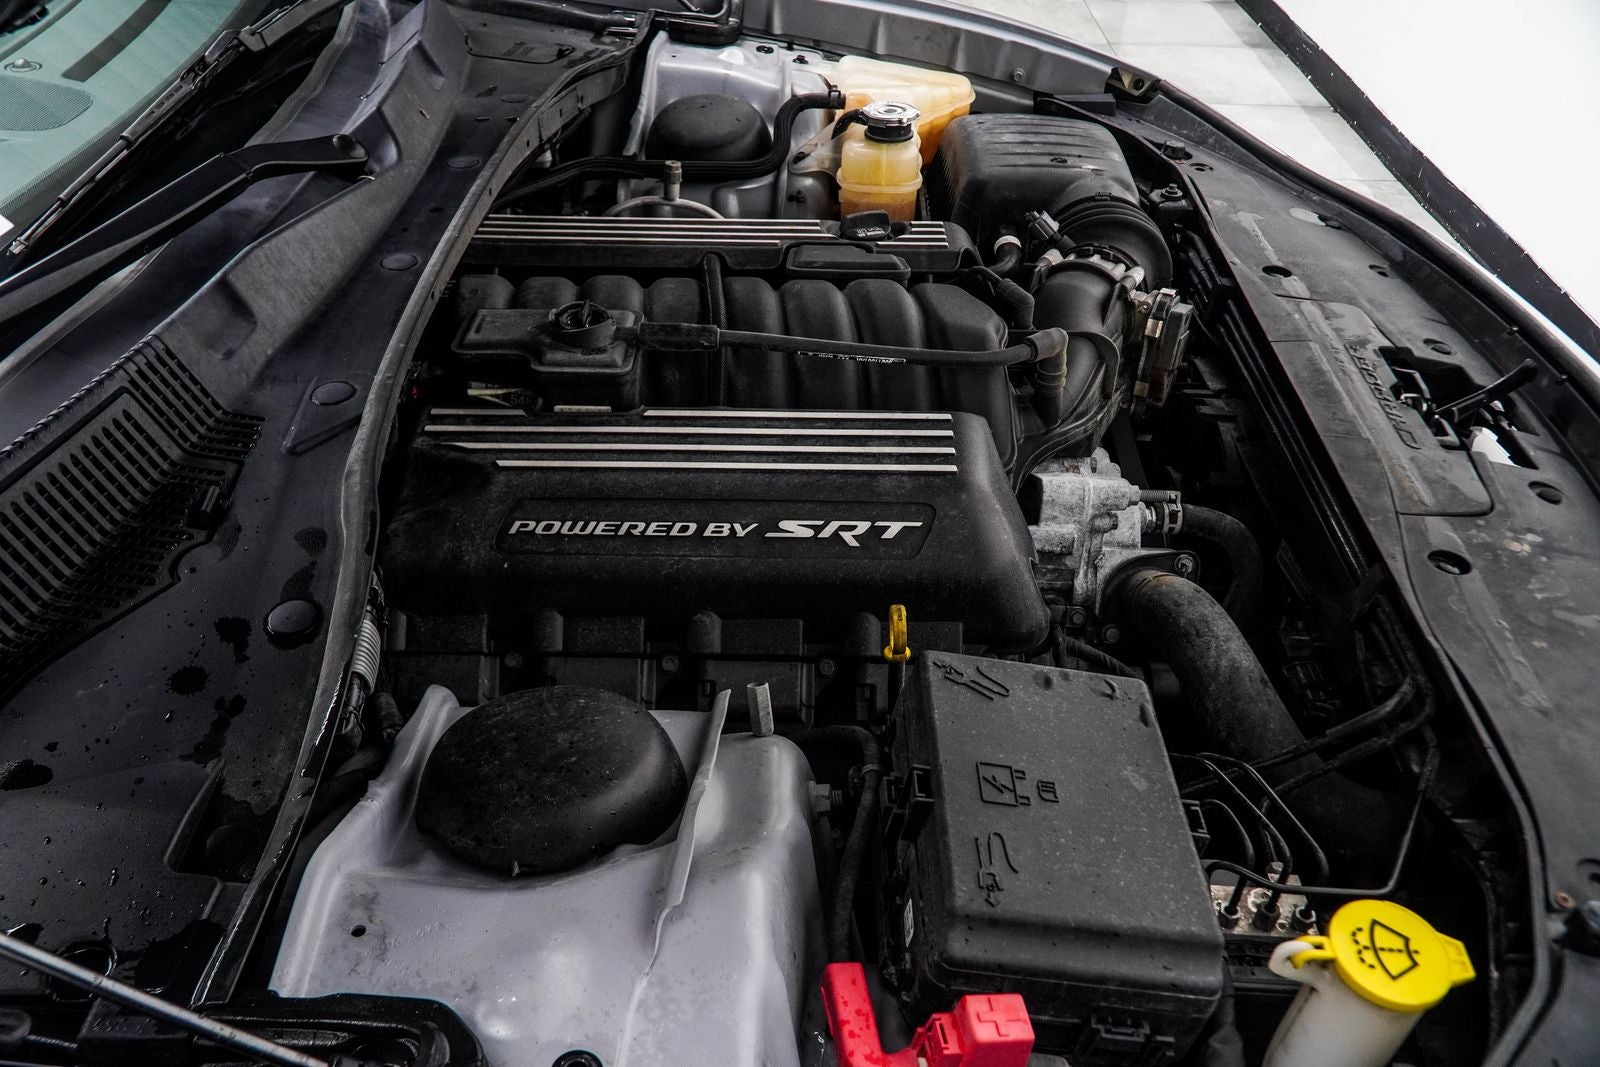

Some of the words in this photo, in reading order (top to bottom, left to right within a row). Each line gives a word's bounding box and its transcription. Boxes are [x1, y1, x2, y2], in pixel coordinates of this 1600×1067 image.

[508, 520, 698, 537] POWERED
[702, 522, 759, 537] BY
[764, 519, 924, 547] SRT
